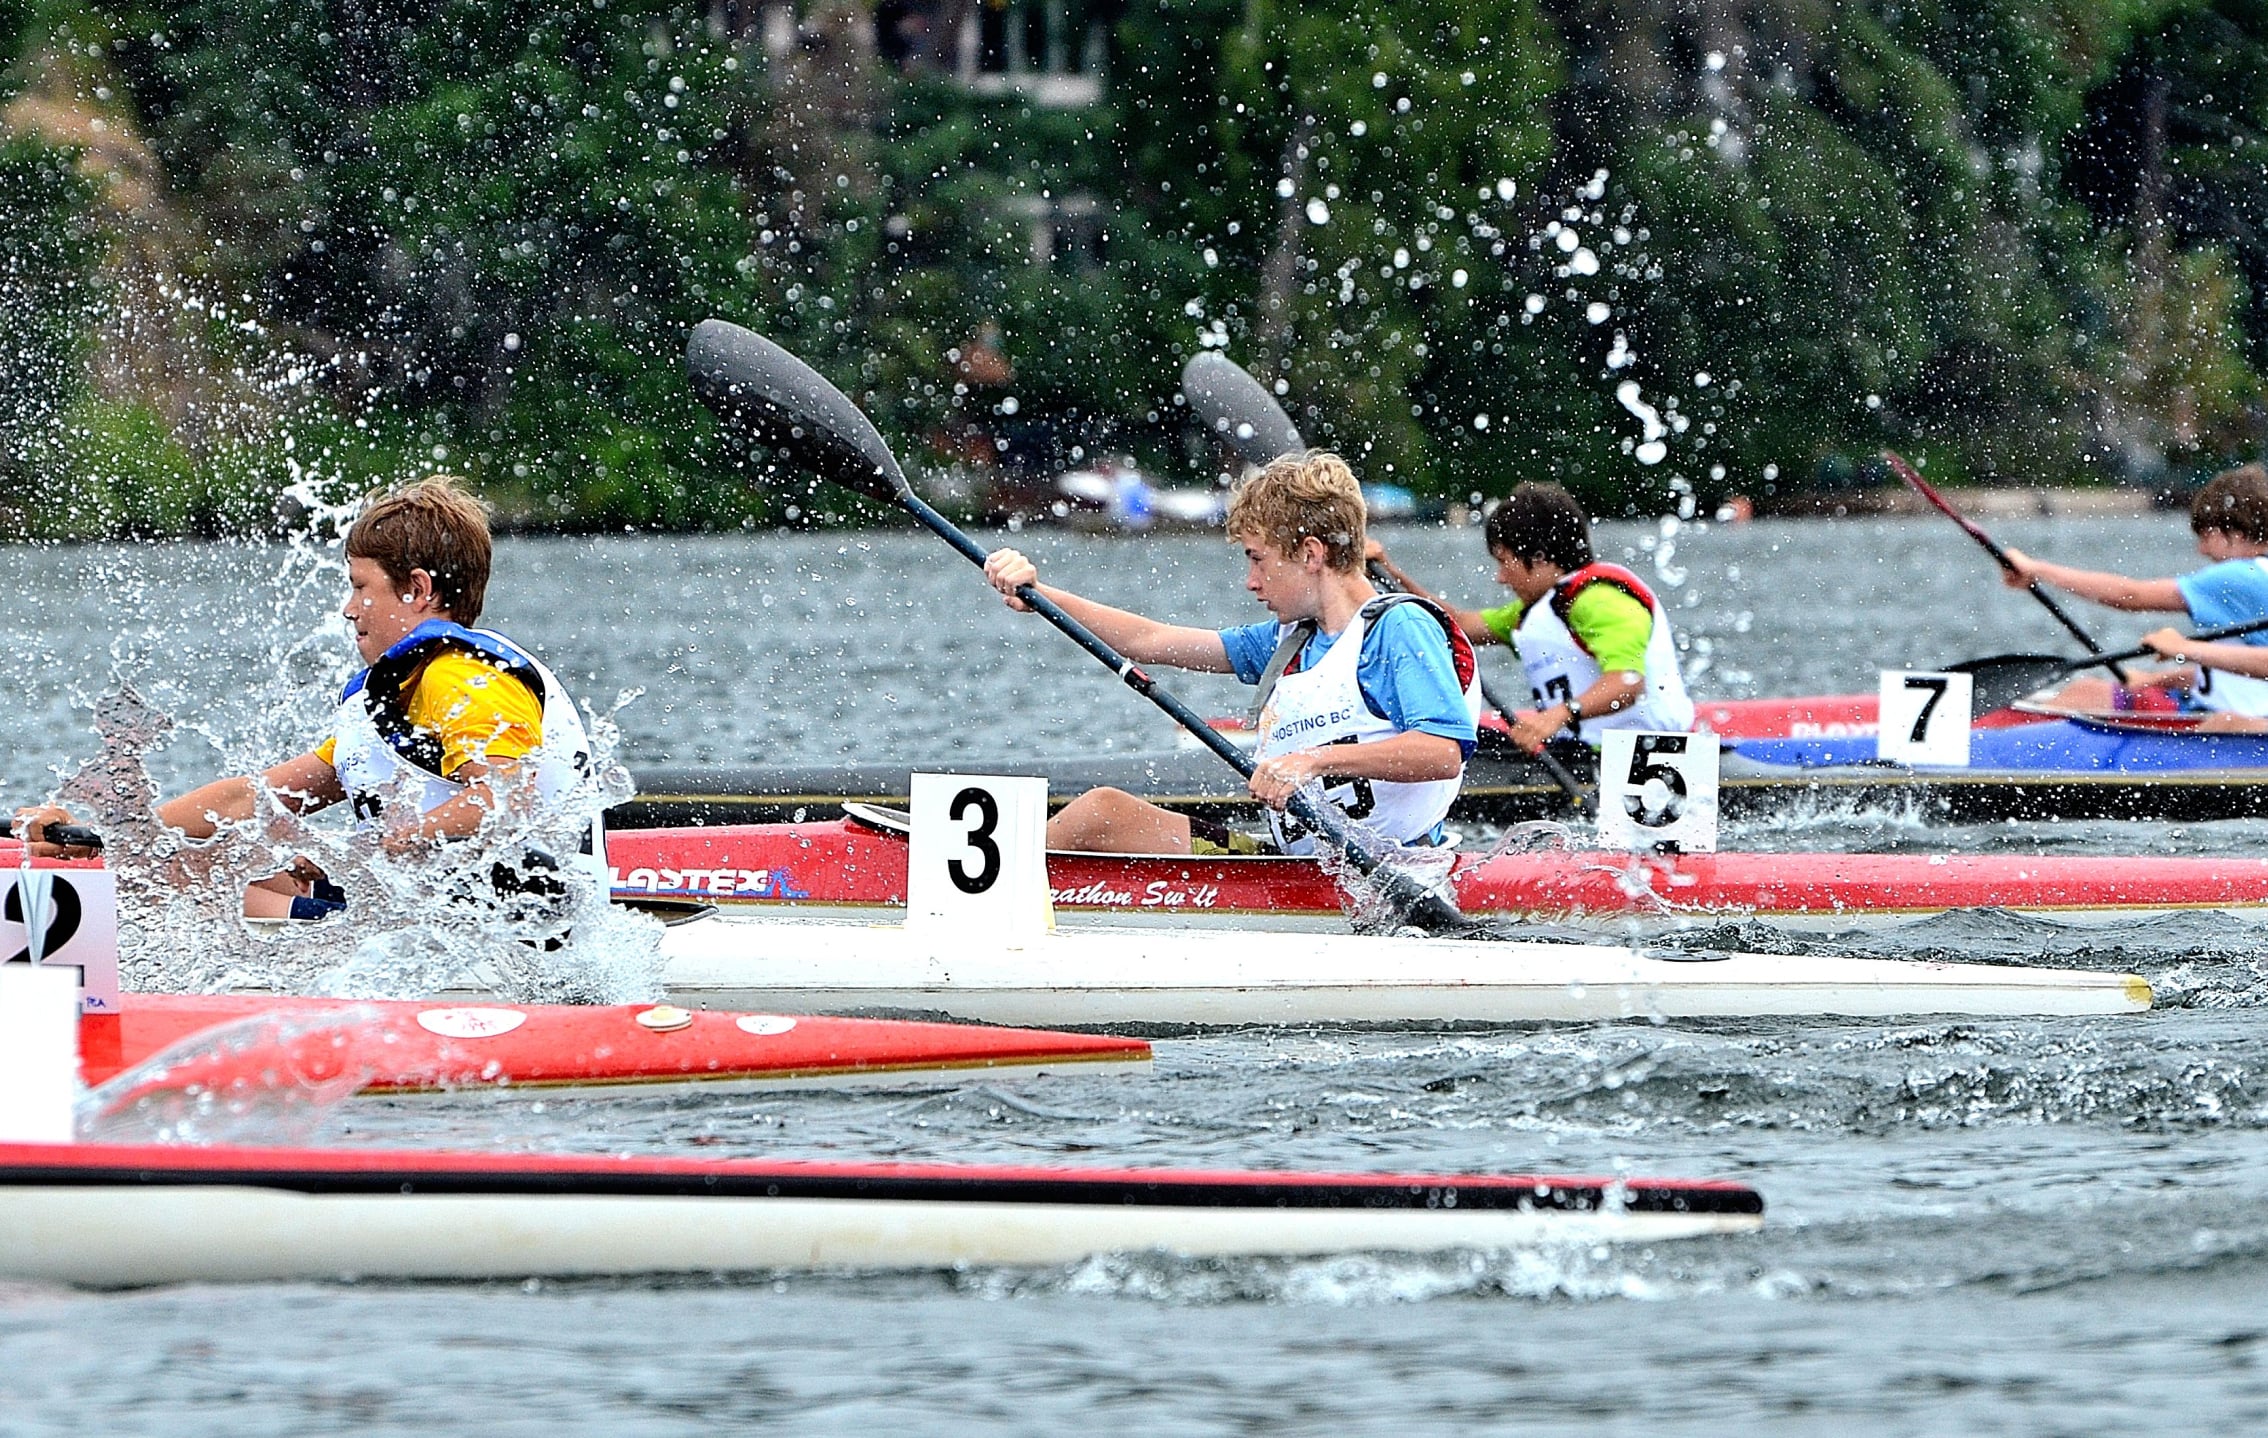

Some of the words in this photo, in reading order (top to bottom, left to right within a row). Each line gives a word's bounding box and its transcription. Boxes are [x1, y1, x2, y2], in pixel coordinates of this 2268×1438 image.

[1904, 676, 1949, 743] 7
[1623, 734, 1688, 828] 5
[947, 787, 1001, 894] 3
[3, 873, 84, 988] 2
